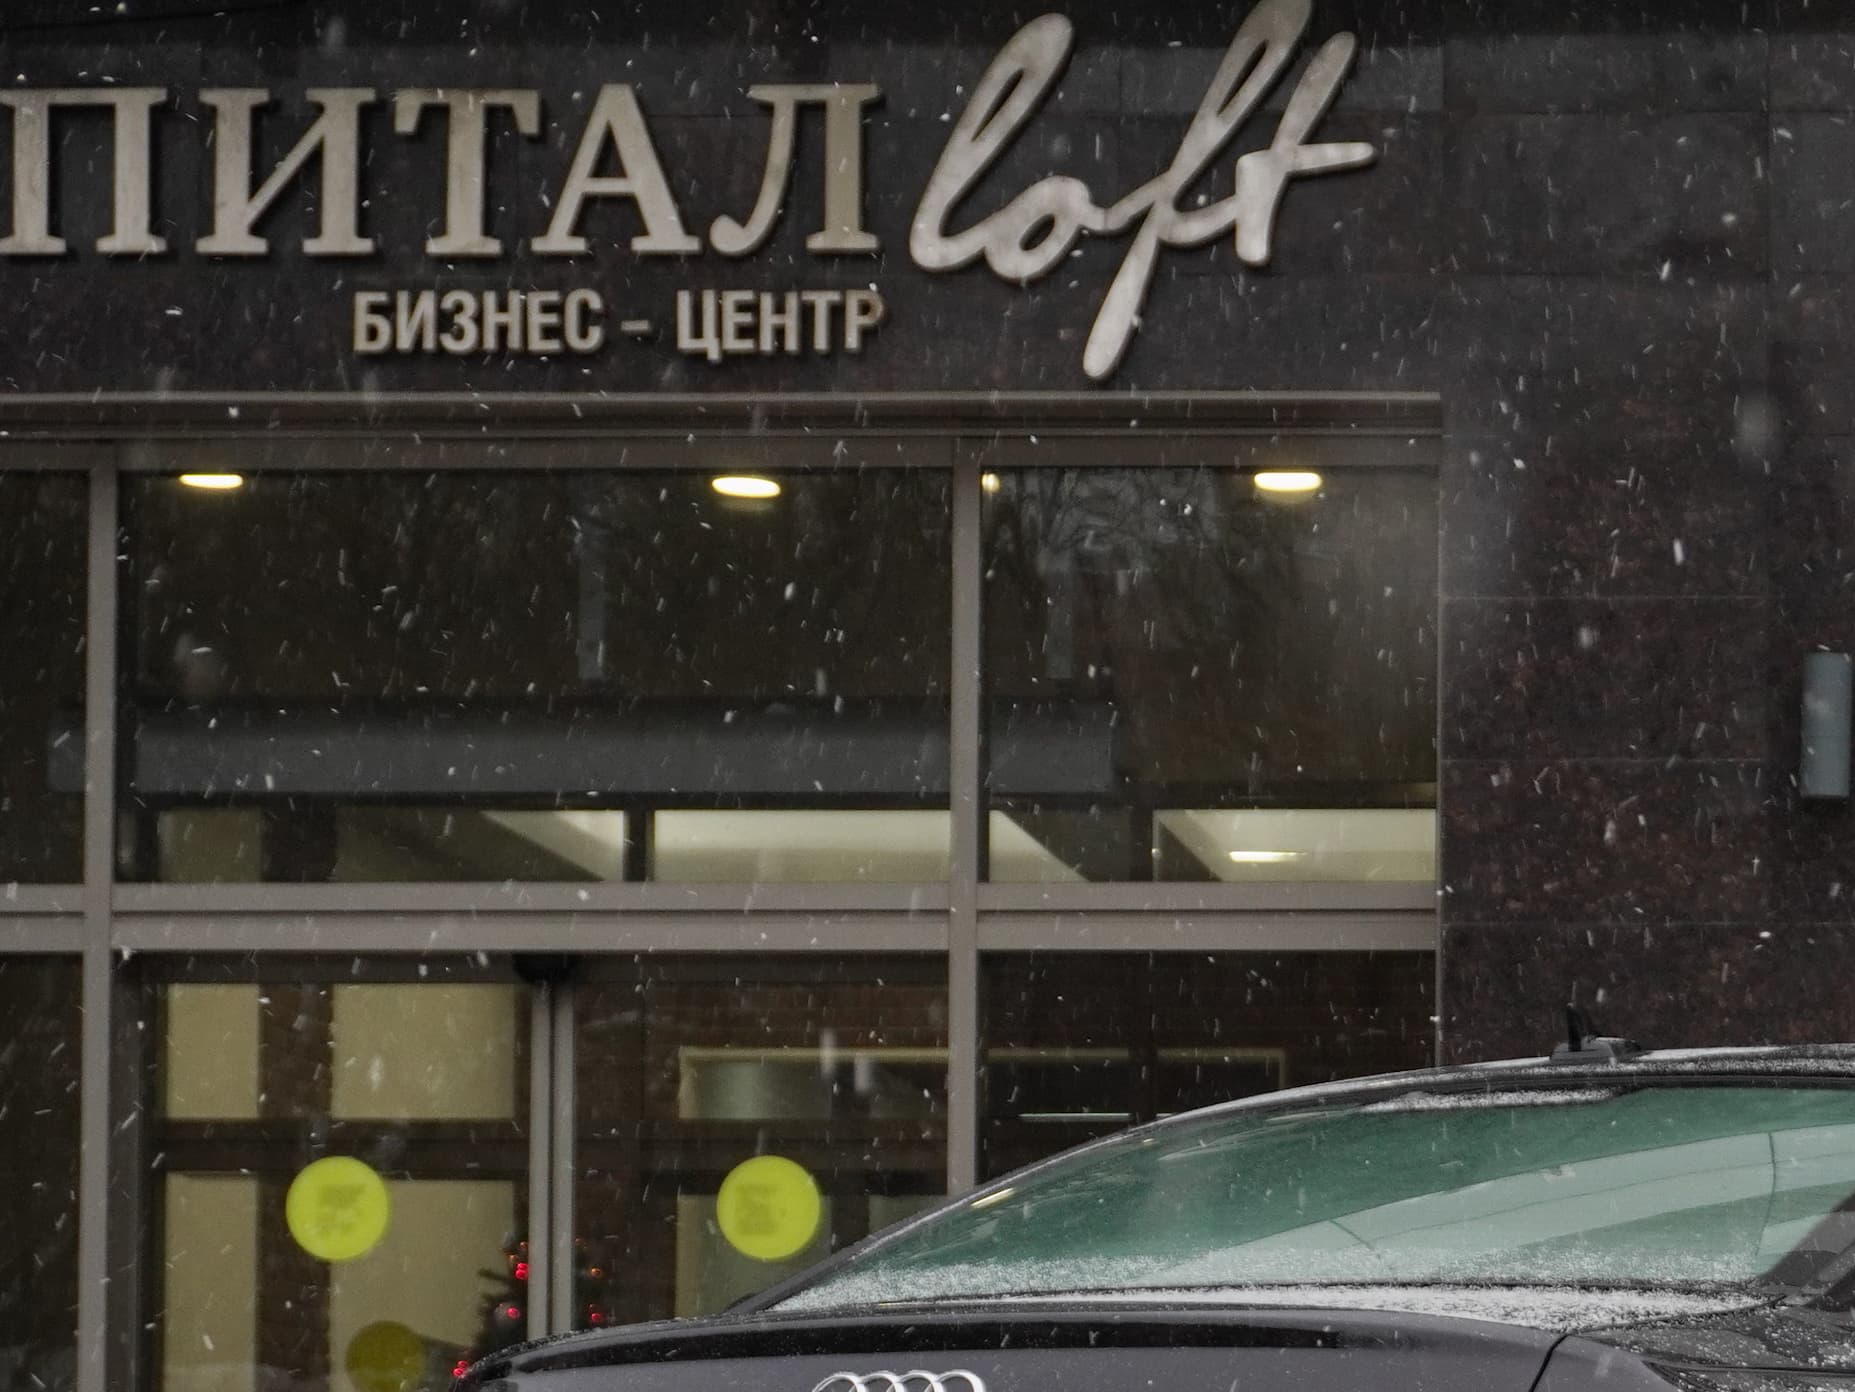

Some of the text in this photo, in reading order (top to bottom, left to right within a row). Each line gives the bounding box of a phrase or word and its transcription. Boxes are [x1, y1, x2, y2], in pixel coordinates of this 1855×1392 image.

[0, 84, 881, 255] ПИТАЛ
[910, 0, 1376, 379] loft
[352, 289, 605, 354] БИЗНЕС
[675, 289, 884, 362] ЦЕНТР
